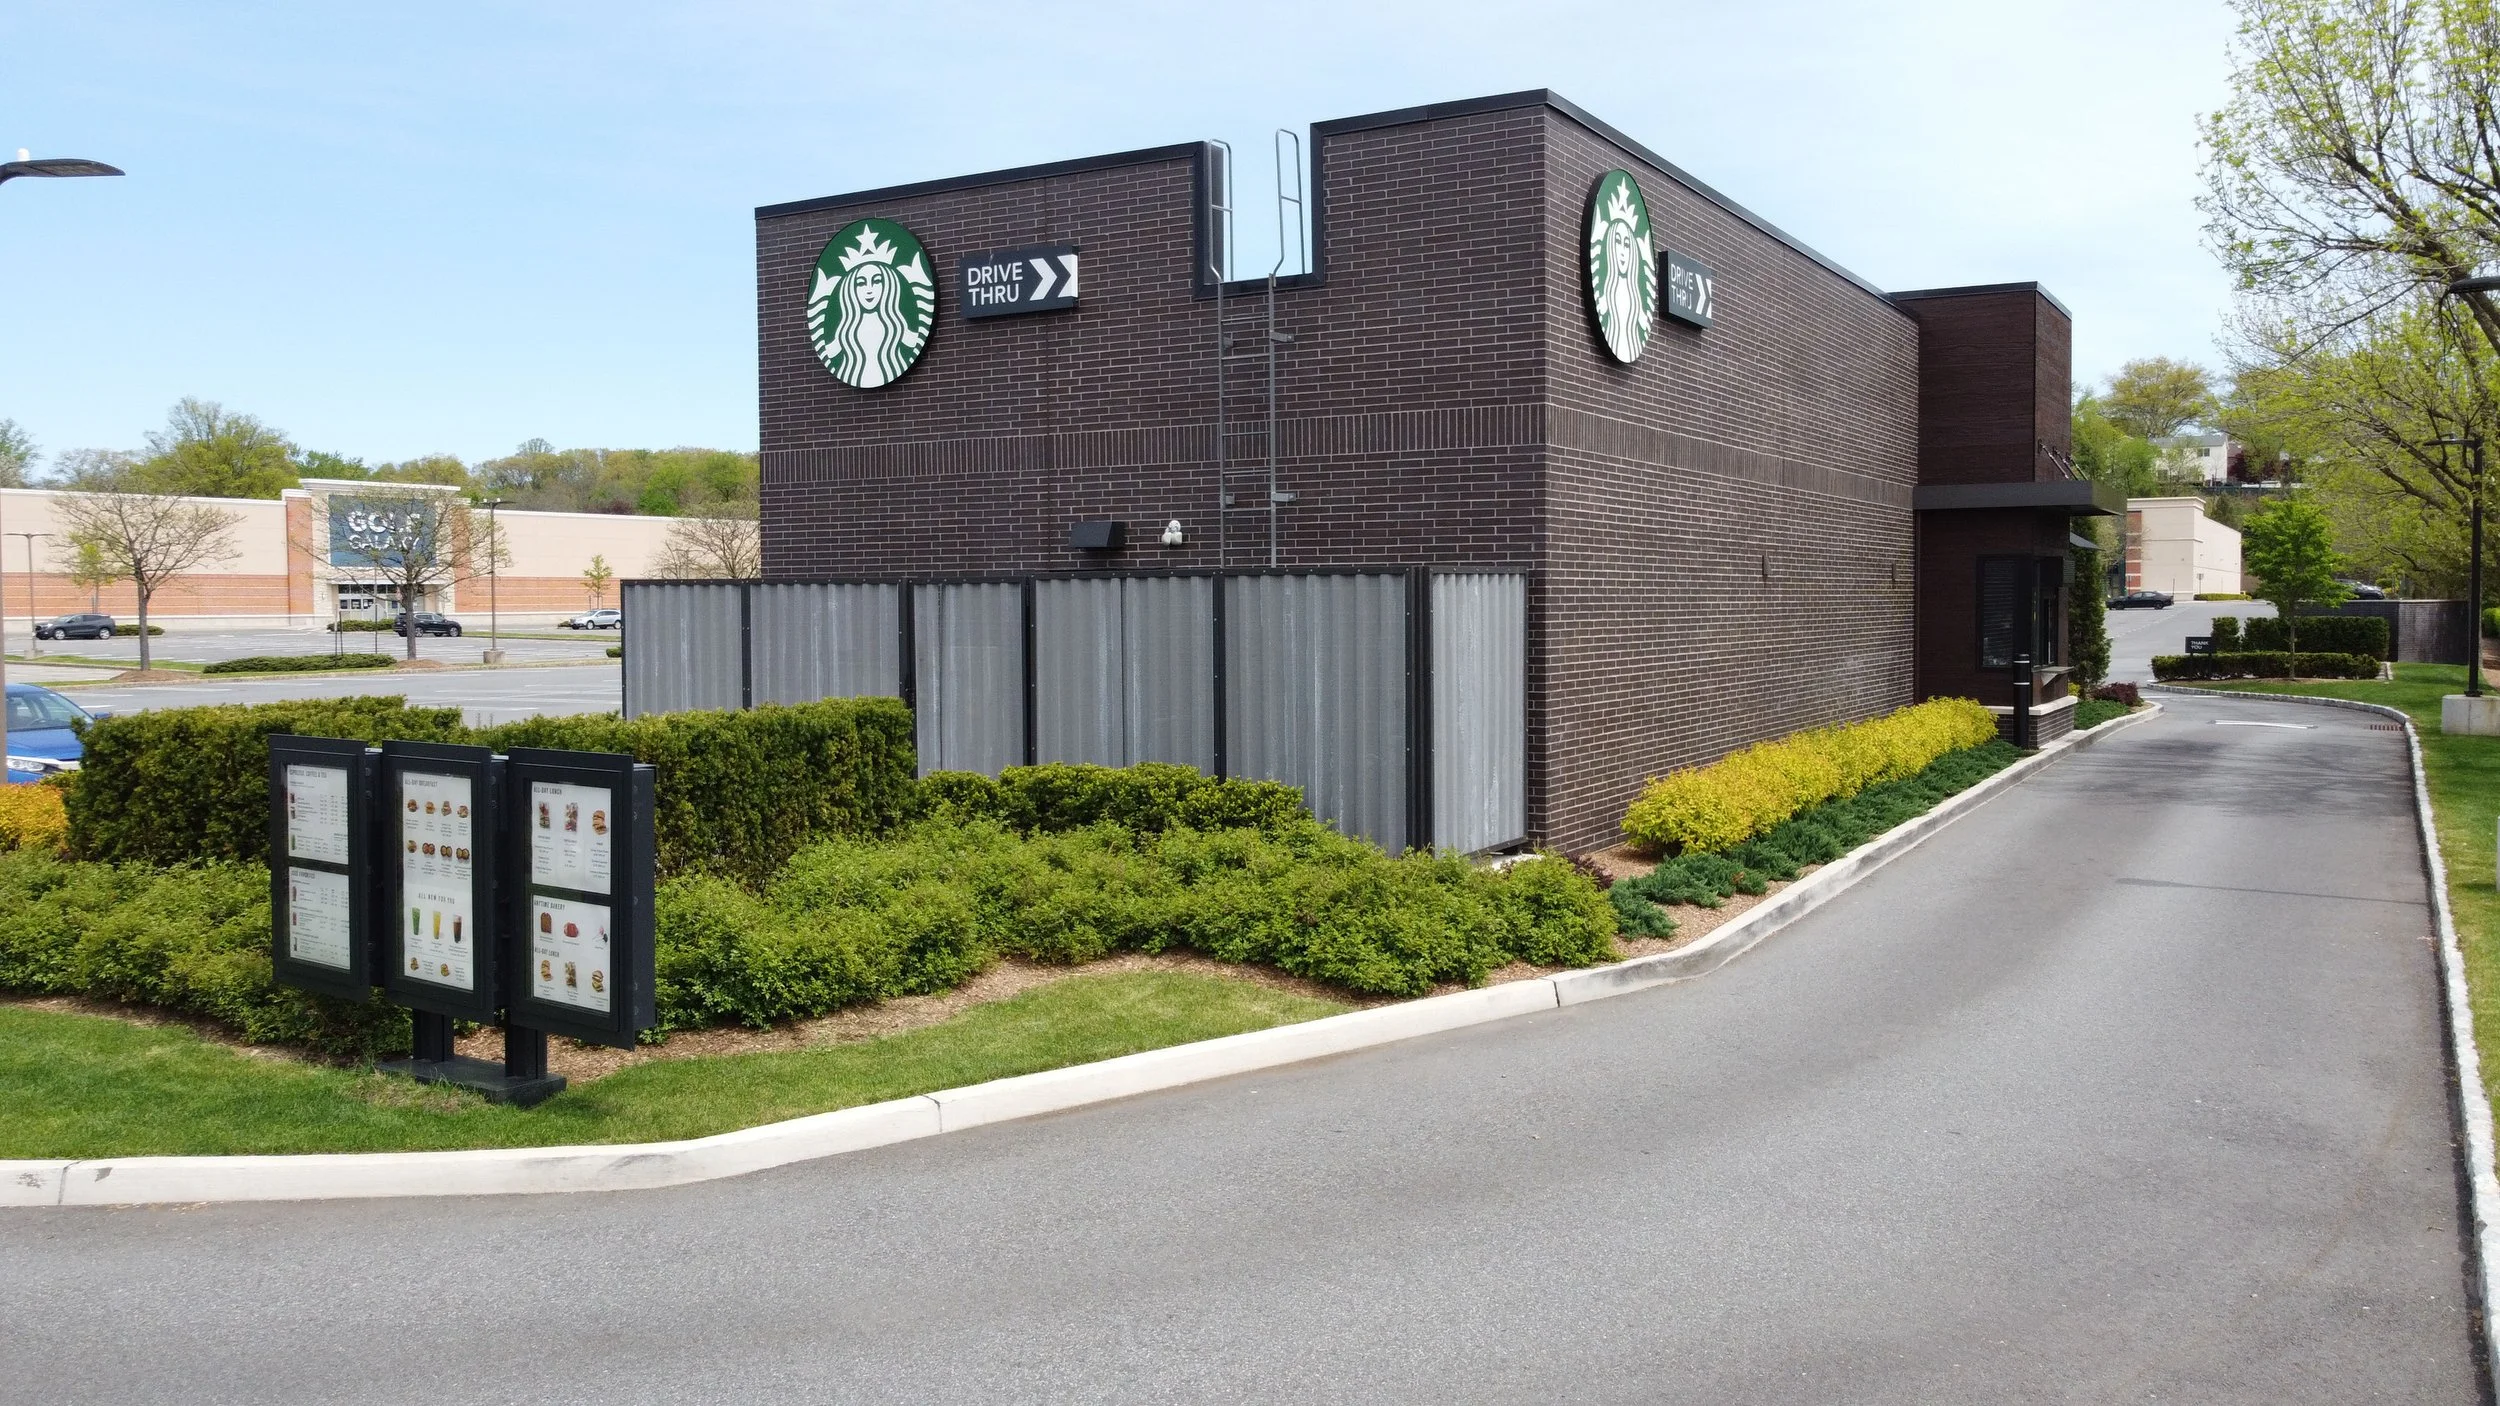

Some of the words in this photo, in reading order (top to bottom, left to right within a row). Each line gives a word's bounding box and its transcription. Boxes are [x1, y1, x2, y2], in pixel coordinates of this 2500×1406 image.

[968, 262, 1023, 286] DRIVE
[1671, 263, 1694, 290] DRIVE
[968, 283, 1019, 306] THRU
[1671, 285, 1692, 310] THRU
[428, 893, 436, 901] NEW
[438, 895, 446, 904] FOR
[447, 897, 455, 905] YOU
[550, 901, 566, 911] BAKERY
[548, 949, 560, 958] LUNCH
